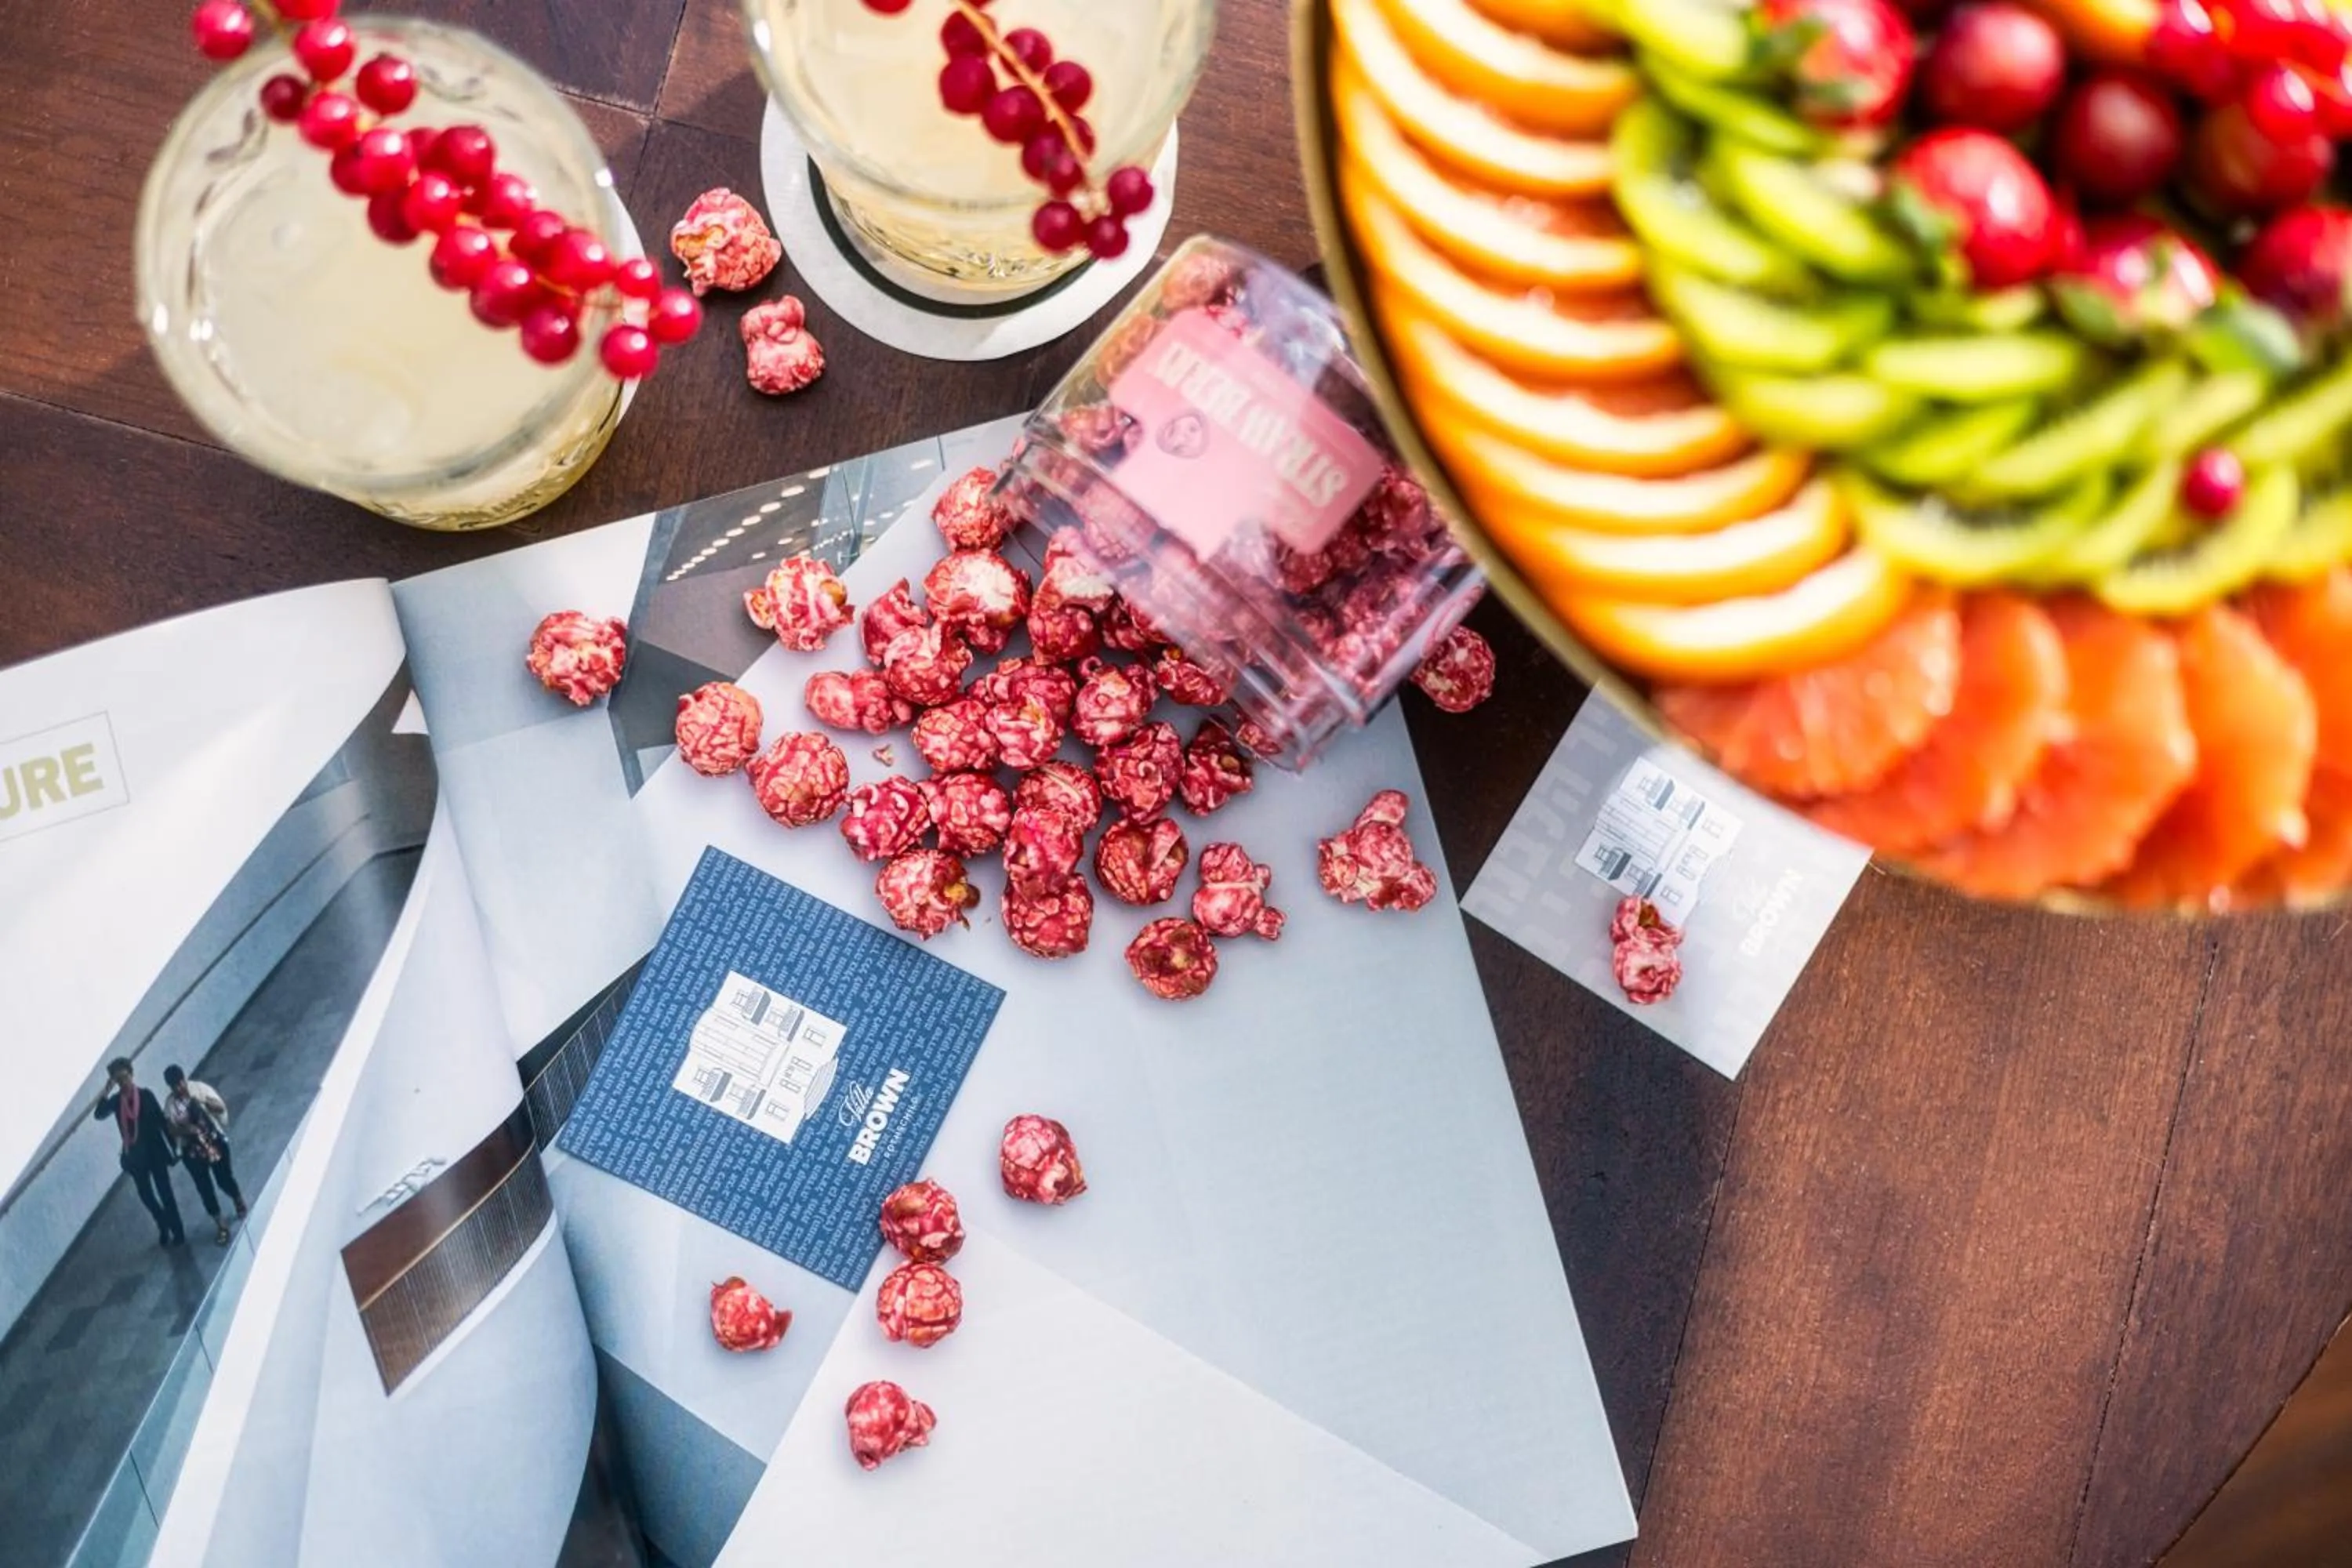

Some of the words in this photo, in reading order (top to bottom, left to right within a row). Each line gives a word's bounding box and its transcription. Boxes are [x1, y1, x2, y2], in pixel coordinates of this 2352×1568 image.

[1740, 869, 1803, 956] BROWN
[840, 1082, 873, 1125] Villa
[848, 1068, 909, 1164] BROWN
